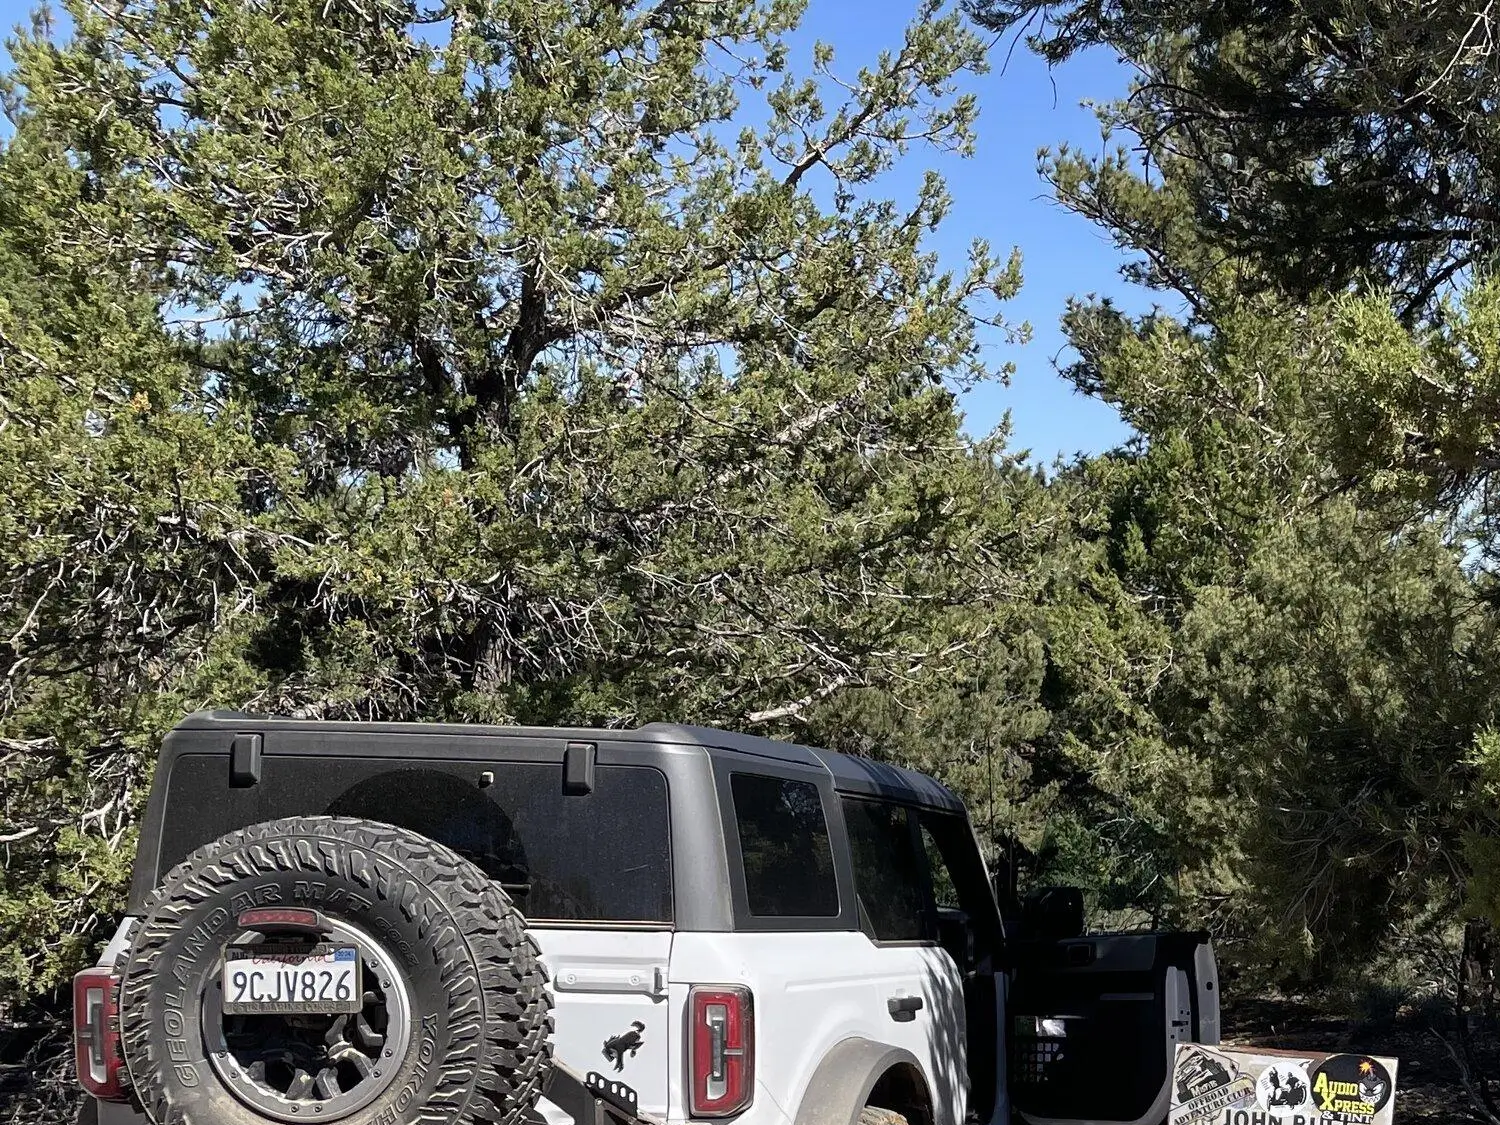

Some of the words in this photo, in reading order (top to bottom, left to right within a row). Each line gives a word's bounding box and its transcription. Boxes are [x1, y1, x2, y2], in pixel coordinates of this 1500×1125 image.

[252, 954, 329, 969] California
[163, 883, 282, 1088] GEOLANDAR
[233, 970, 351, 1002] 9CJV826
[1313, 1072, 1358, 1096] AUDIO
[1188, 1086, 1229, 1110] OFFROAD
[1320, 1092, 1375, 1114] XPRESS
[1322, 1110, 1334, 1120] &
[1338, 1112, 1373, 1124] TINT
